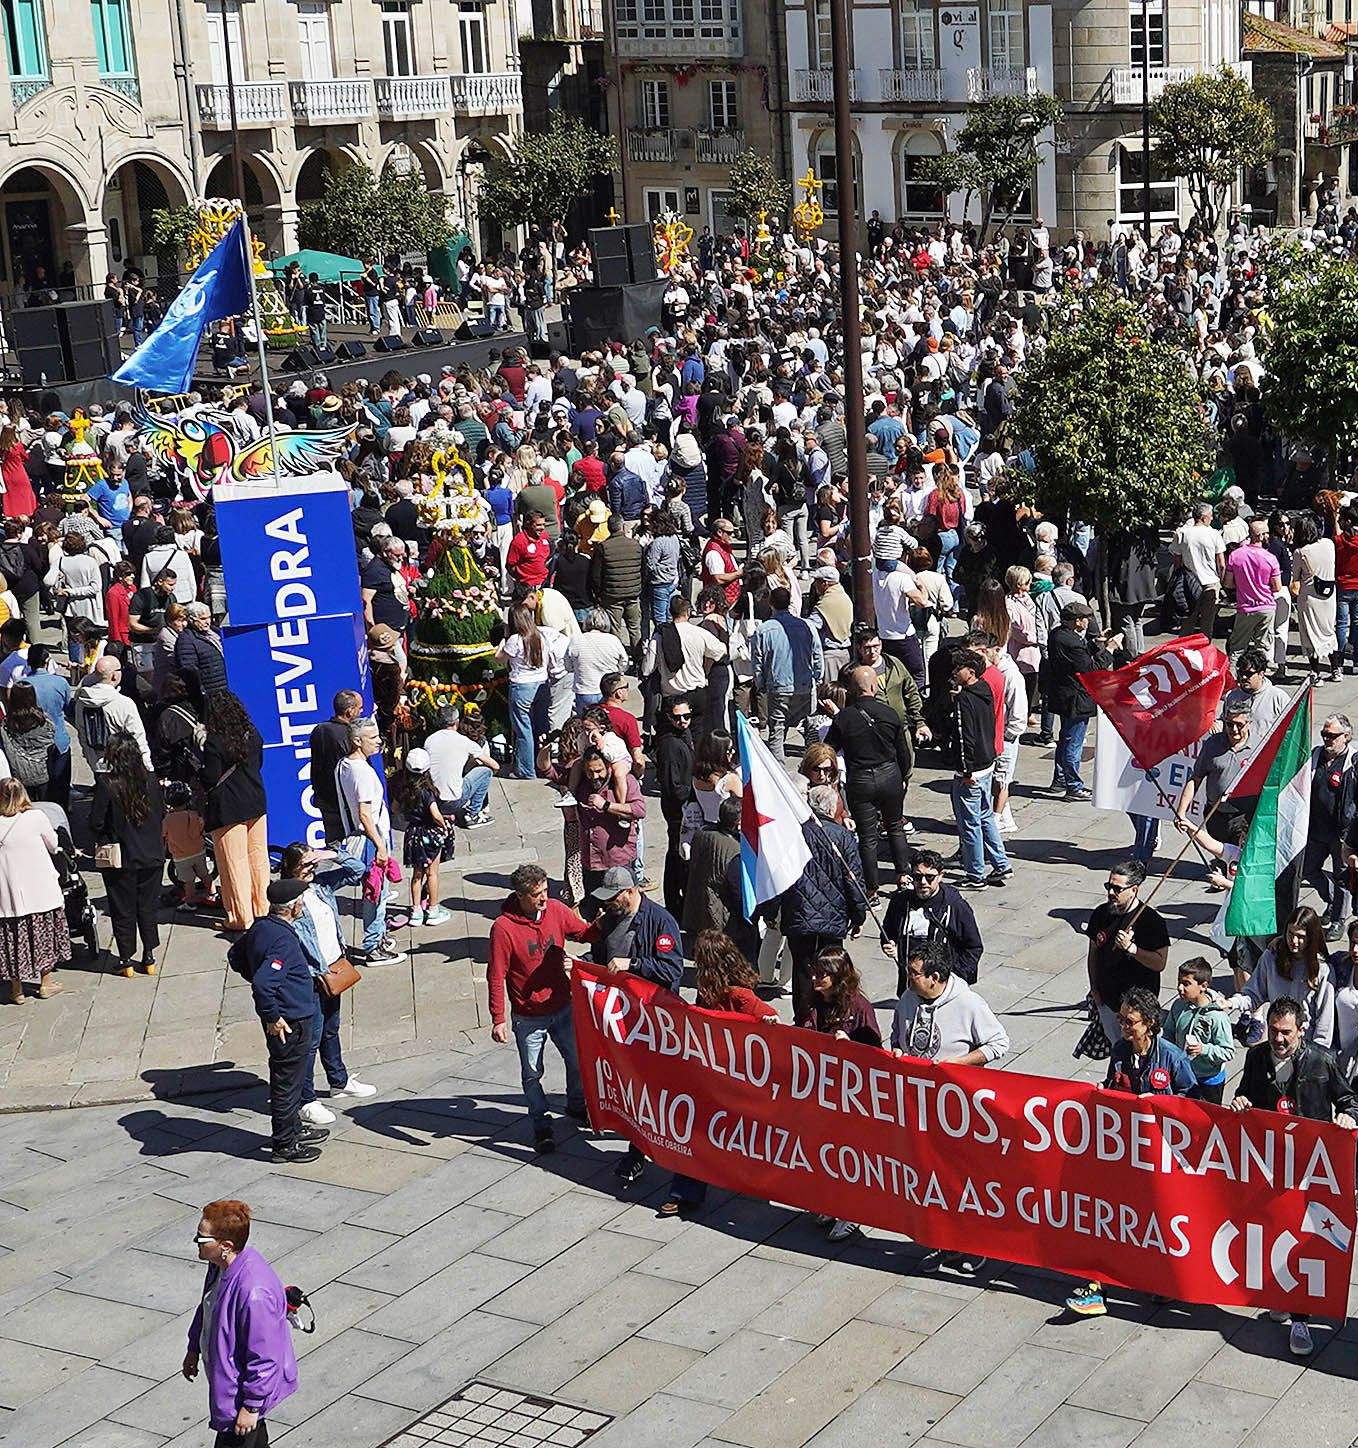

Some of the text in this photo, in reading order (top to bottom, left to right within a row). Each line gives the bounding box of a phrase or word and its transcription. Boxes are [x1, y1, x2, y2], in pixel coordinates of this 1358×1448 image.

[1156, 792, 1177, 809] 17
[580, 979, 1342, 1195] TRABALLO, DEREITOS, SOBERANÍA
[607, 1083, 620, 1105] DE
[616, 1069, 696, 1145] MAIO
[664, 1139, 693, 1157] OBREIRA
[707, 1110, 814, 1173] GALIZA
[819, 1143, 949, 1212] CONTRA
[957, 1177, 1006, 1219] AS
[1016, 1186, 1191, 1258] GUERRAS
[1211, 1219, 1326, 1298] CIG
